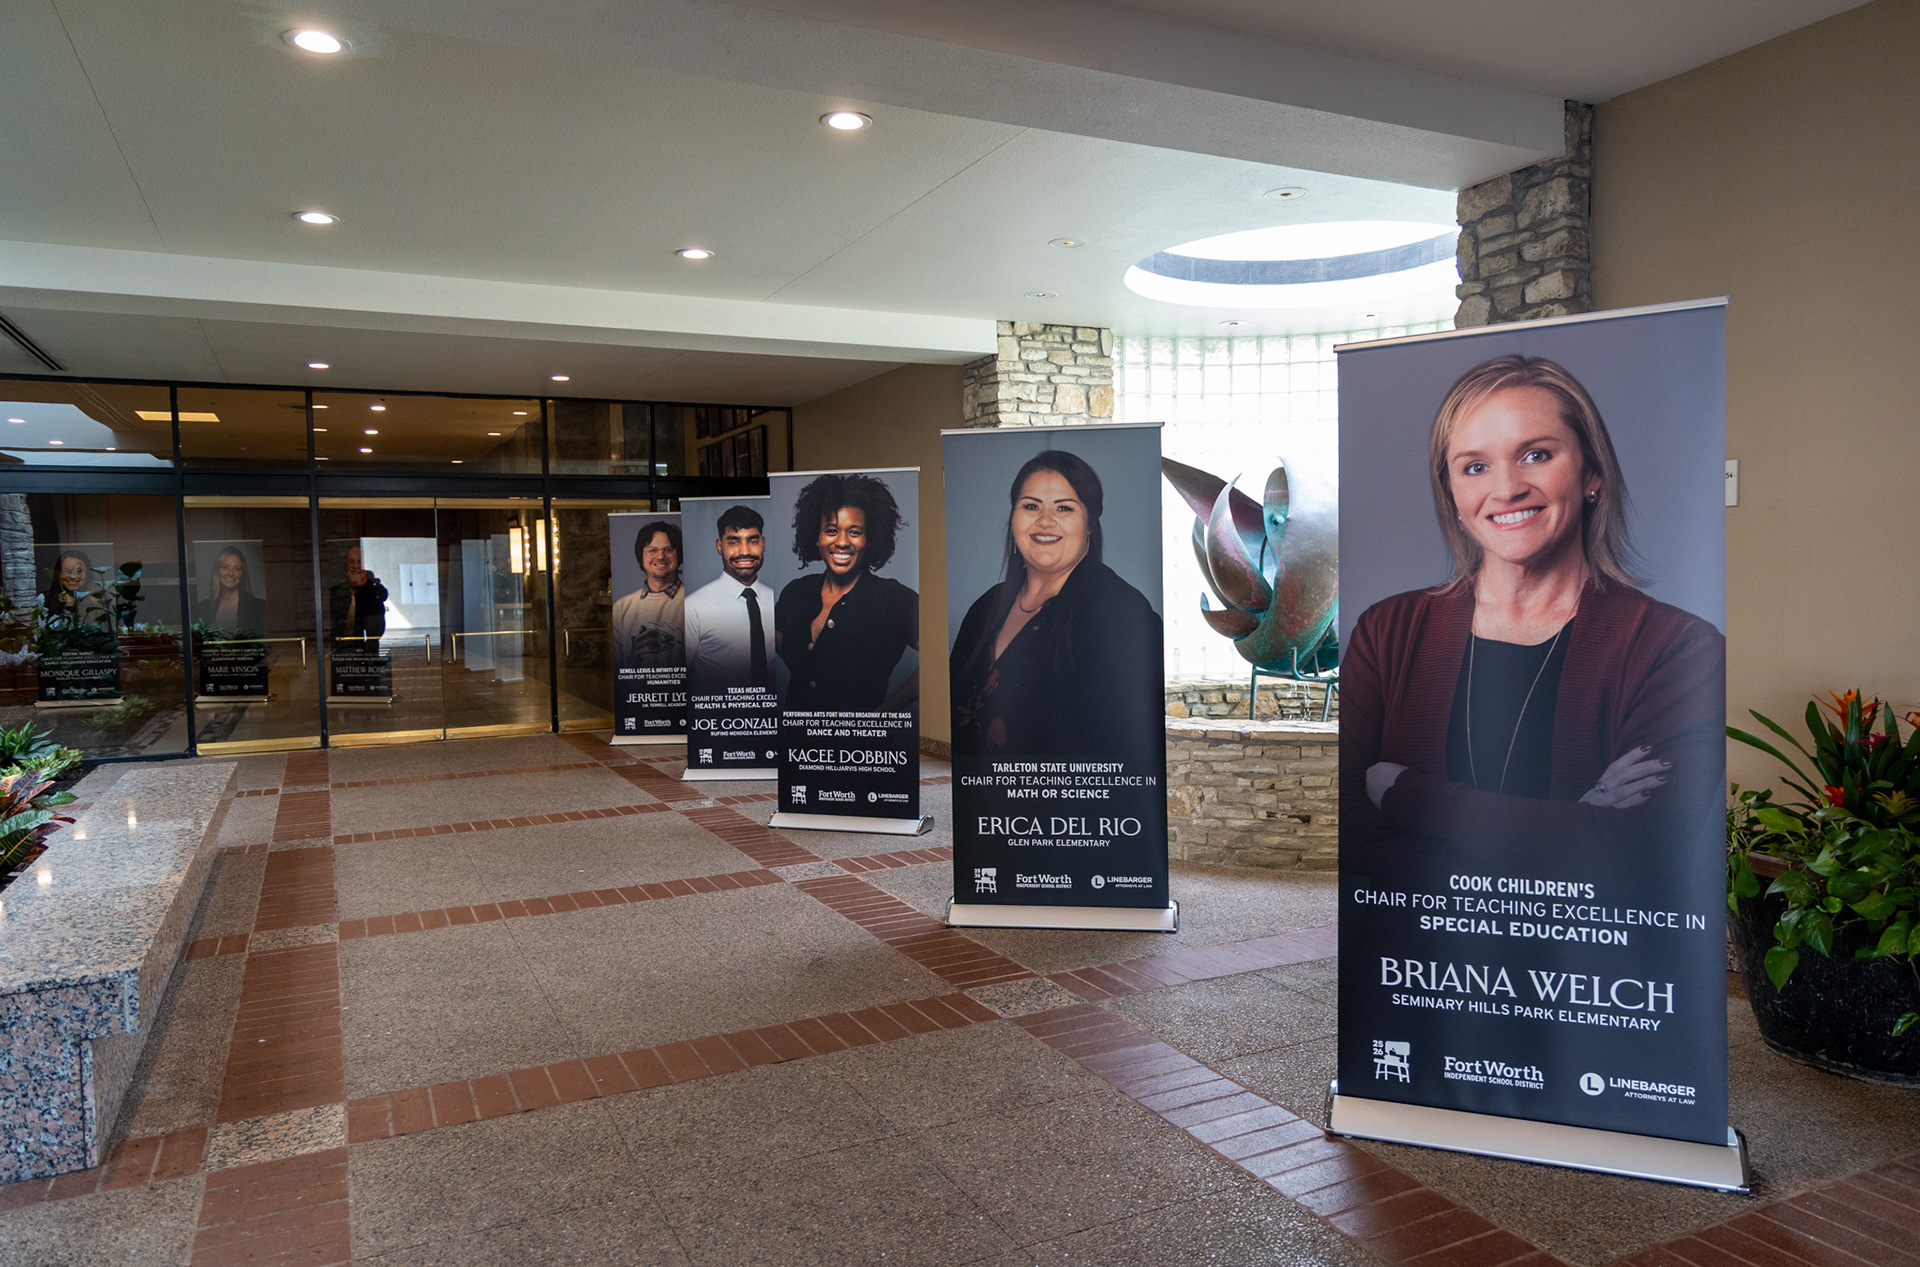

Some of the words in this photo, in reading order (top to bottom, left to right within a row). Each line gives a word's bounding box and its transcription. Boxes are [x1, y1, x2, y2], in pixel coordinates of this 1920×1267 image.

[40, 670, 80, 678] MONIQUE
[626, 693, 669, 703] JERRETT
[692, 719, 718, 730] JOE
[788, 749, 835, 762] KACEE
[840, 749, 908, 765] DOBBINS
[992, 763, 1038, 773] TARLETON
[1040, 763, 1067, 773] STATE
[1069, 763, 1124, 773] UNIVERSITY
[961, 776, 993, 786] CHAIR
[996, 776, 1016, 786] FOR
[1019, 776, 1072, 786] TEACHING
[1075, 776, 1143, 786] EXCELLENCE
[1146, 776, 1156, 786] IN
[833, 790, 855, 798] Worth
[1007, 789, 1038, 798] MATH
[1042, 789, 1057, 799] OR
[1060, 789, 1110, 799] SCIENCE
[978, 816, 1044, 835] ERICA
[1050, 817, 1091, 836] DEL
[1099, 817, 1142, 836] RIO
[1056, 839, 1111, 847] ELEMENTARY
[1016, 874, 1037, 883] Fort
[1038, 874, 1072, 884] Worth
[1450, 875, 1493, 892] COOK
[1498, 877, 1595, 899] CHILDREN'S
[1354, 889, 1406, 907] CHAIR
[1412, 894, 1447, 910] FOR
[1452, 896, 1546, 917] TEACHING
[1552, 903, 1679, 928] EXCELLENCE
[1686, 914, 1705, 930] IN
[1420, 915, 1503, 935] SPECIAL
[1510, 922, 1628, 946] EDUCATION
[1380, 957, 1517, 997] BRIANA
[1527, 970, 1674, 1014] WELCH
[1392, 993, 1464, 1011] SEMINARY
[1468, 1001, 1510, 1015] HILLS
[1514, 1005, 1554, 1020] PARK
[1559, 1010, 1661, 1031] ELEMENTARY
[1372, 1040, 1383, 1048] 25
[1444, 1056, 1482, 1074] Fort
[1483, 1060, 1544, 1082] Worth
[1444, 1071, 1487, 1083] INDEPENDENT
[1489, 1077, 1513, 1086] SCHOOL
[1515, 1080, 1544, 1090] DISTRICT
[1610, 1077, 1696, 1097] LINEBARGER
[1624, 1092, 1666, 1102] ATTORNEYS
